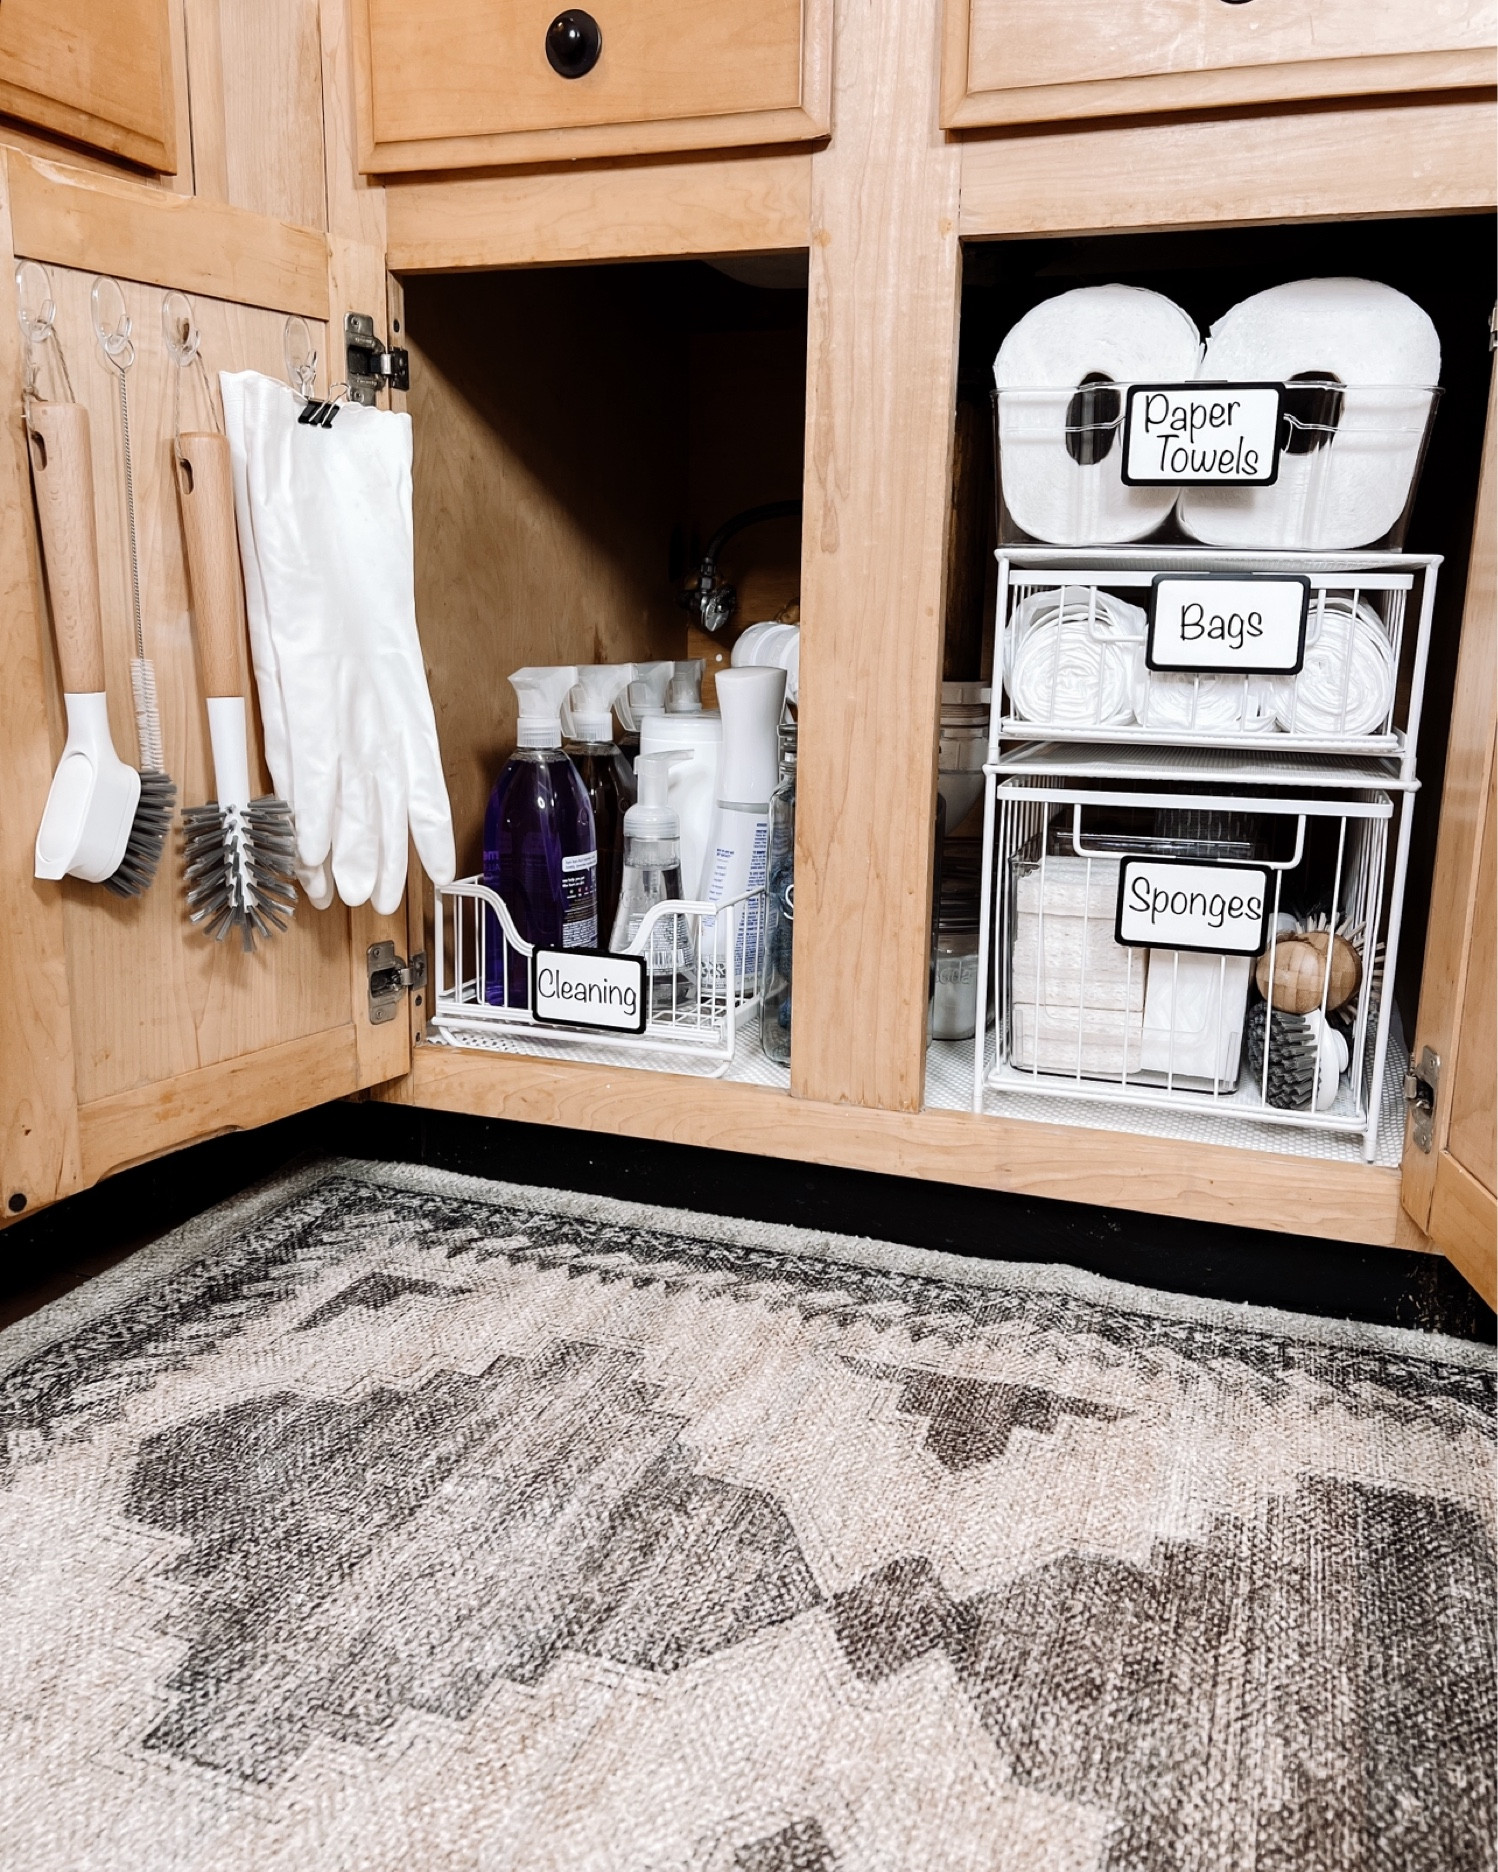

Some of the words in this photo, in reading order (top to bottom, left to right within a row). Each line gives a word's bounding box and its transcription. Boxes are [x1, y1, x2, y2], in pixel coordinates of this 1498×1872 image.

[1144, 393, 1241, 444] Paper
[1156, 434, 1259, 476] Towels
[1180, 603, 1264, 650] Bags
[1128, 876, 1263, 928] Sponges
[537, 967, 637, 1016] Cleaning
